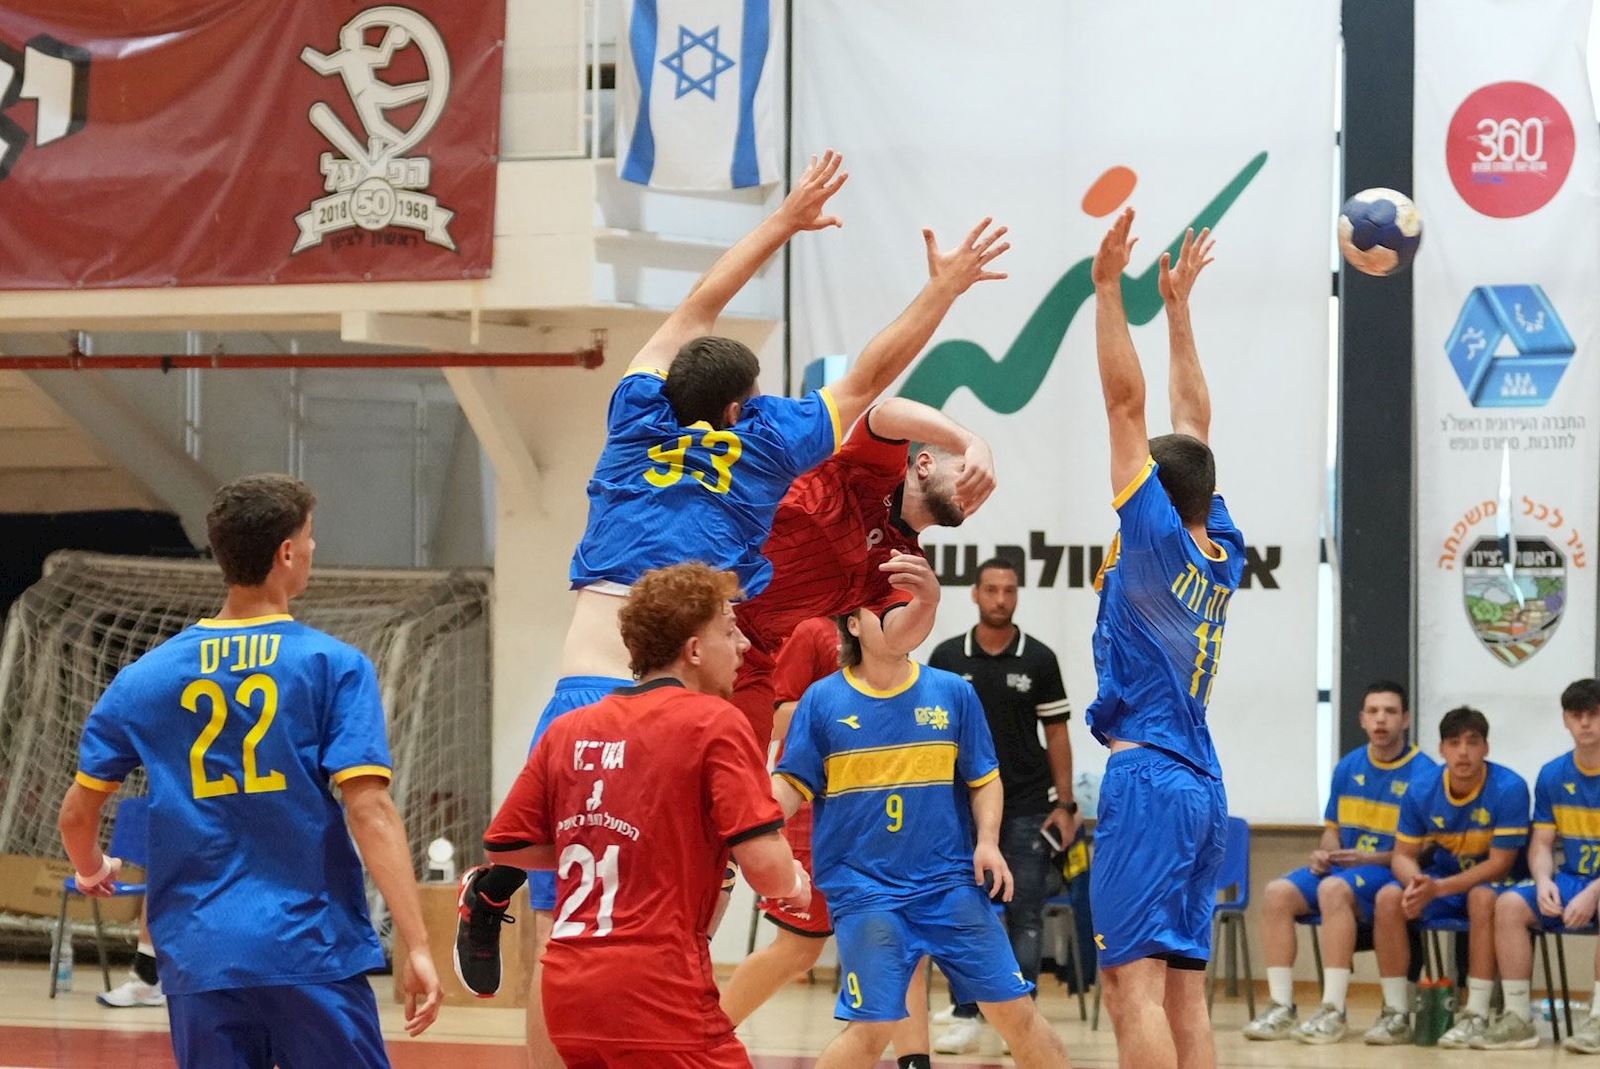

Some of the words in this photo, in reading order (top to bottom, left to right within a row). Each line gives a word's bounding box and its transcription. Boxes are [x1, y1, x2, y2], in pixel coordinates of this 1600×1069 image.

[319, 200, 348, 224] 2018
[399, 200, 429, 221] 1968
[355, 188, 392, 216] 50
[1520, 495, 1564, 529] לכל
[1189, 622, 1223, 707] 11
[180, 673, 288, 800] 22
[603, 812, 641, 841] הפועל
[885, 793, 903, 833] 9
[550, 843, 620, 939] 21
[847, 971, 863, 1009] 9
